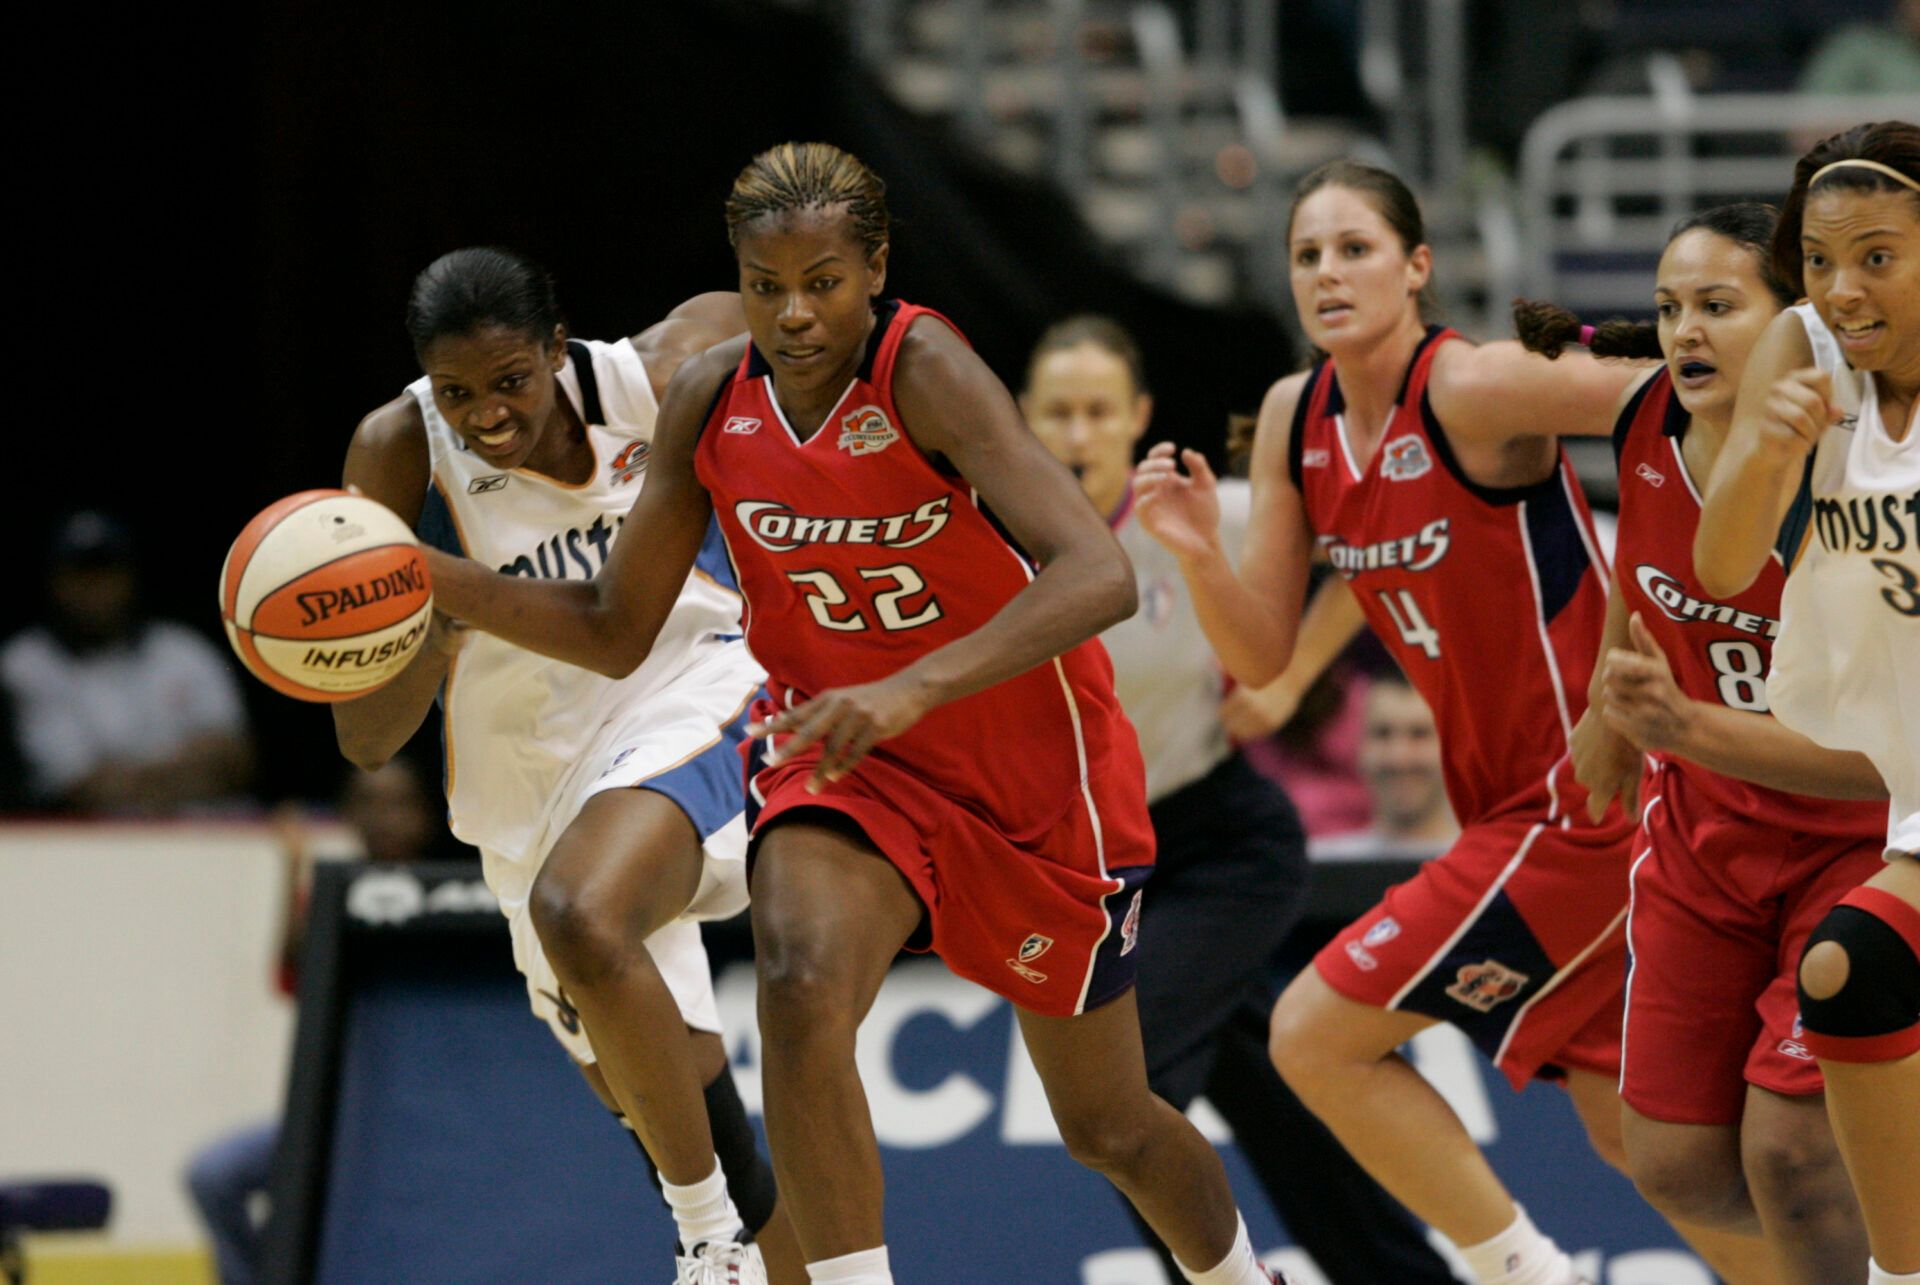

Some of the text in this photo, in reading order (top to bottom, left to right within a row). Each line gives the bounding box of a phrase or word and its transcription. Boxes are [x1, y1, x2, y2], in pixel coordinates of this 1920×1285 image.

[498, 513, 625, 580] yst
[735, 496, 951, 552] COMETS
[297, 558, 425, 626] SPALDING
[787, 564, 944, 632] 22
[1377, 588, 1441, 660] 4
[1708, 640, 1770, 714] 8
